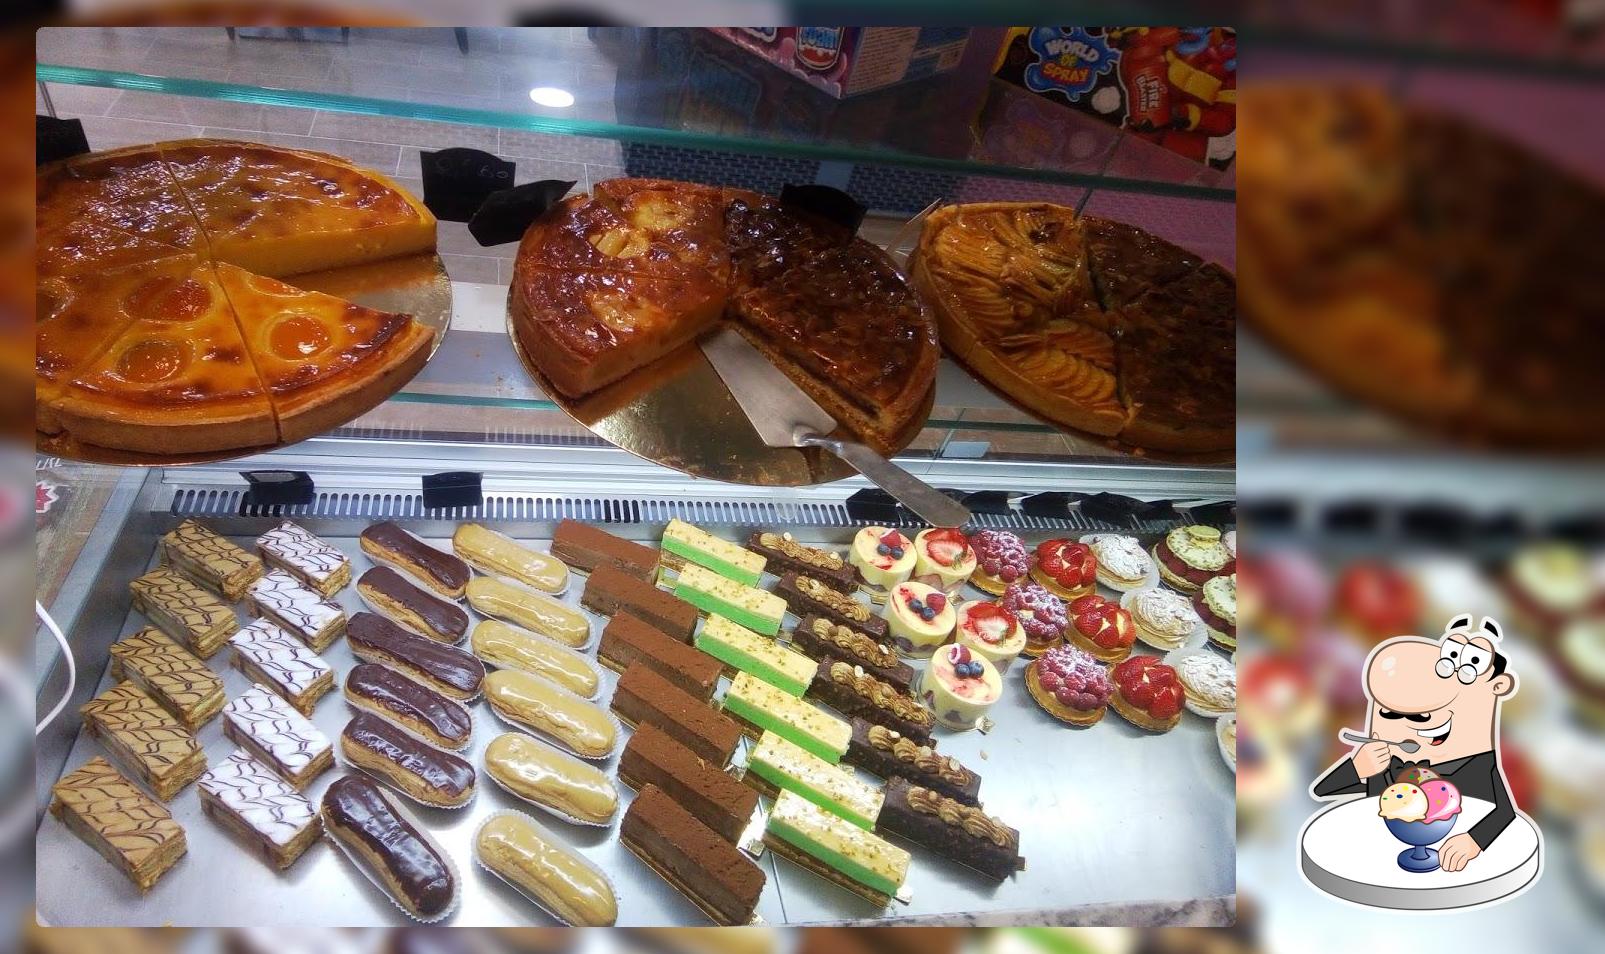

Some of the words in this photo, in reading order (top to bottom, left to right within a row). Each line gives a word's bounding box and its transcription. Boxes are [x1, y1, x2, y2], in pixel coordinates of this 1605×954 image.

[1045, 39, 1100, 62] WORLD
[1060, 53, 1078, 67] OF
[1042, 62, 1090, 83] SPRAY
